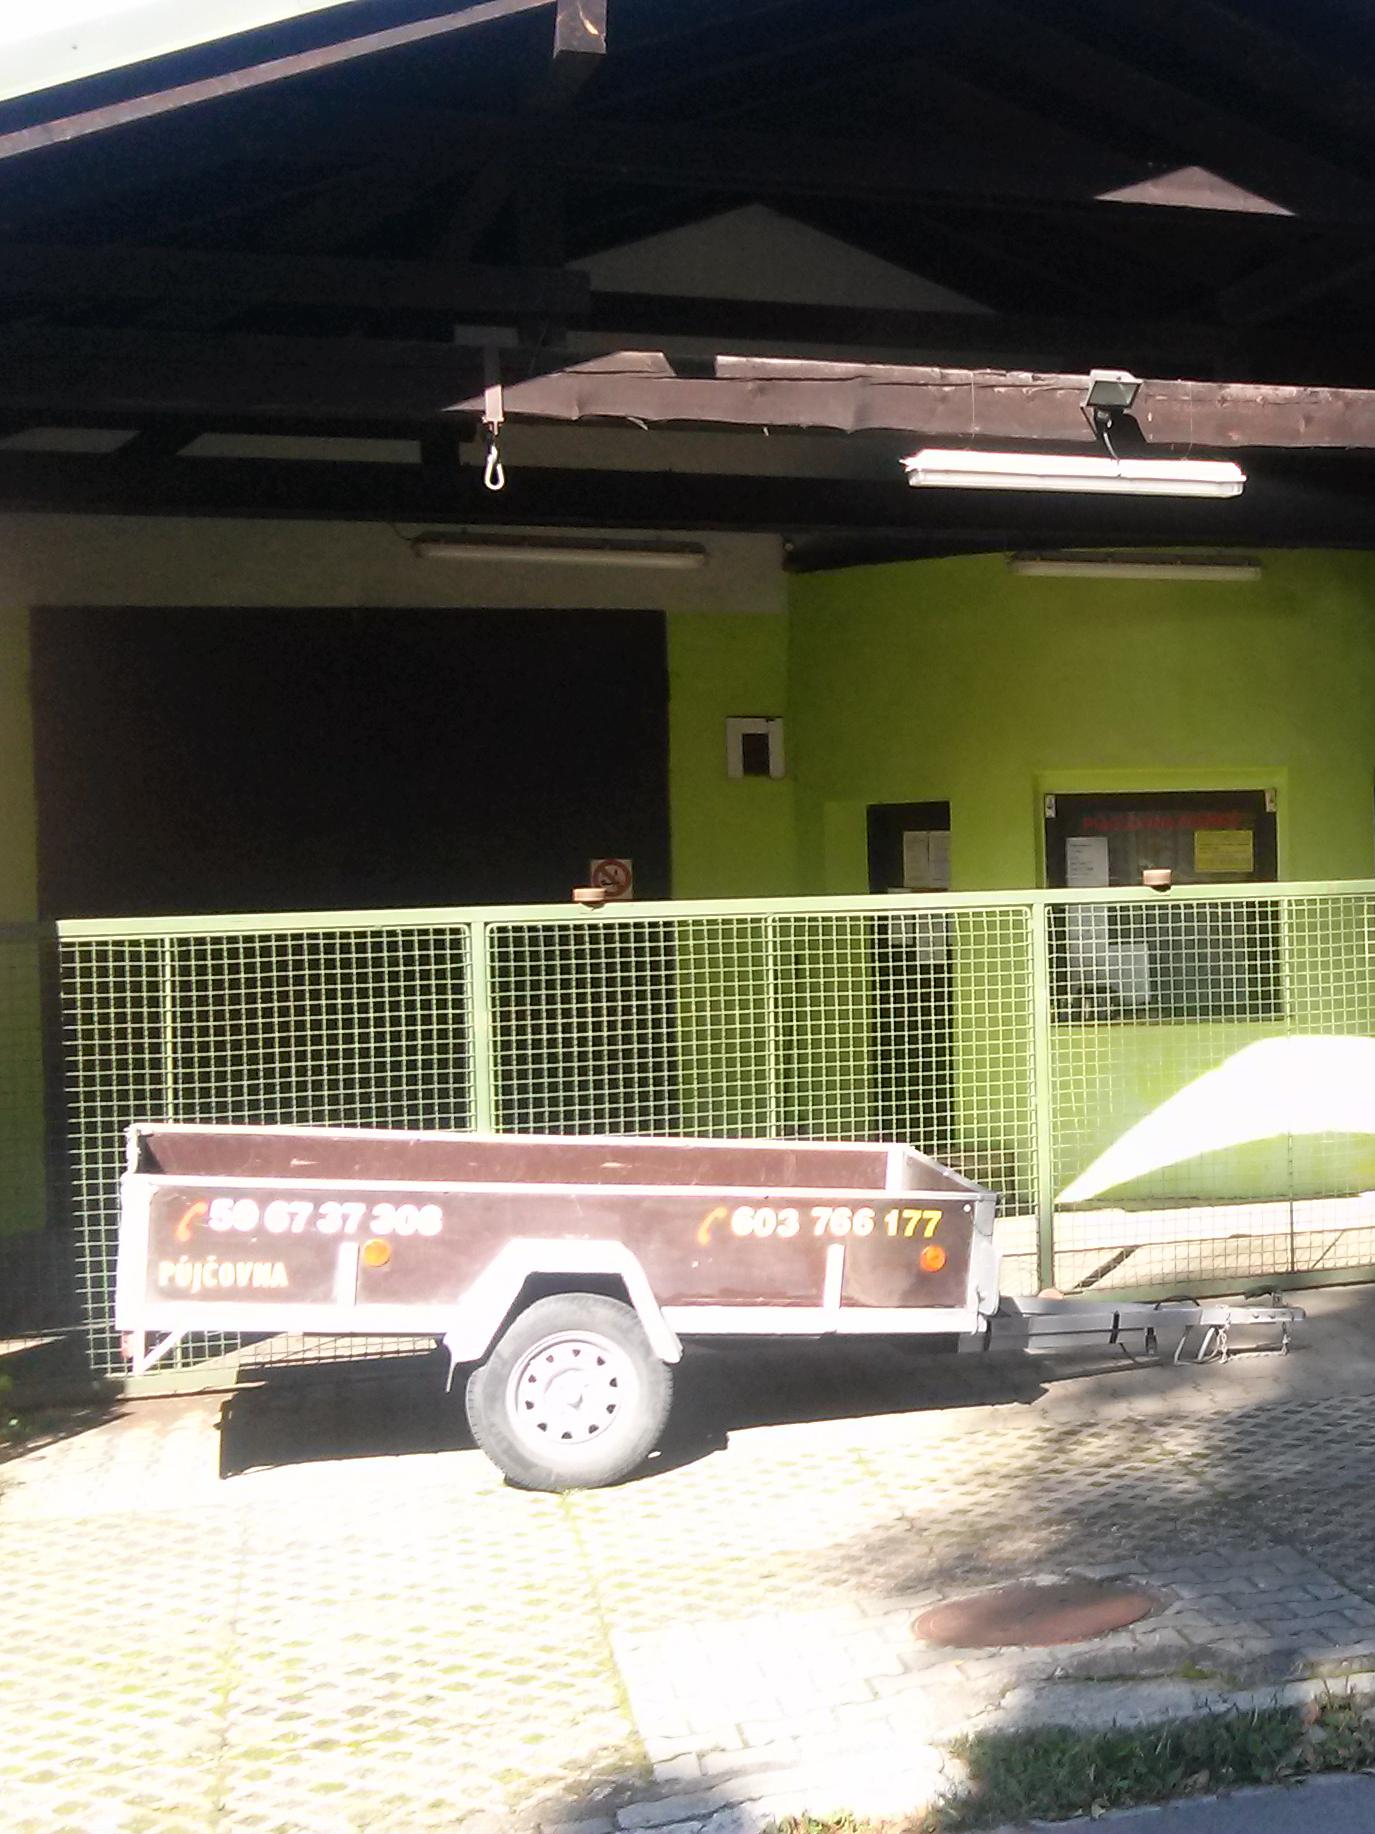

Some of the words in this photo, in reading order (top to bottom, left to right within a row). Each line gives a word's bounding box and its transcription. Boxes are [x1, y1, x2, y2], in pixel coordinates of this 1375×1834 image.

[731, 1206, 801, 1238] 603
[811, 1206, 876, 1238] 766
[884, 1209, 943, 1238] 177
